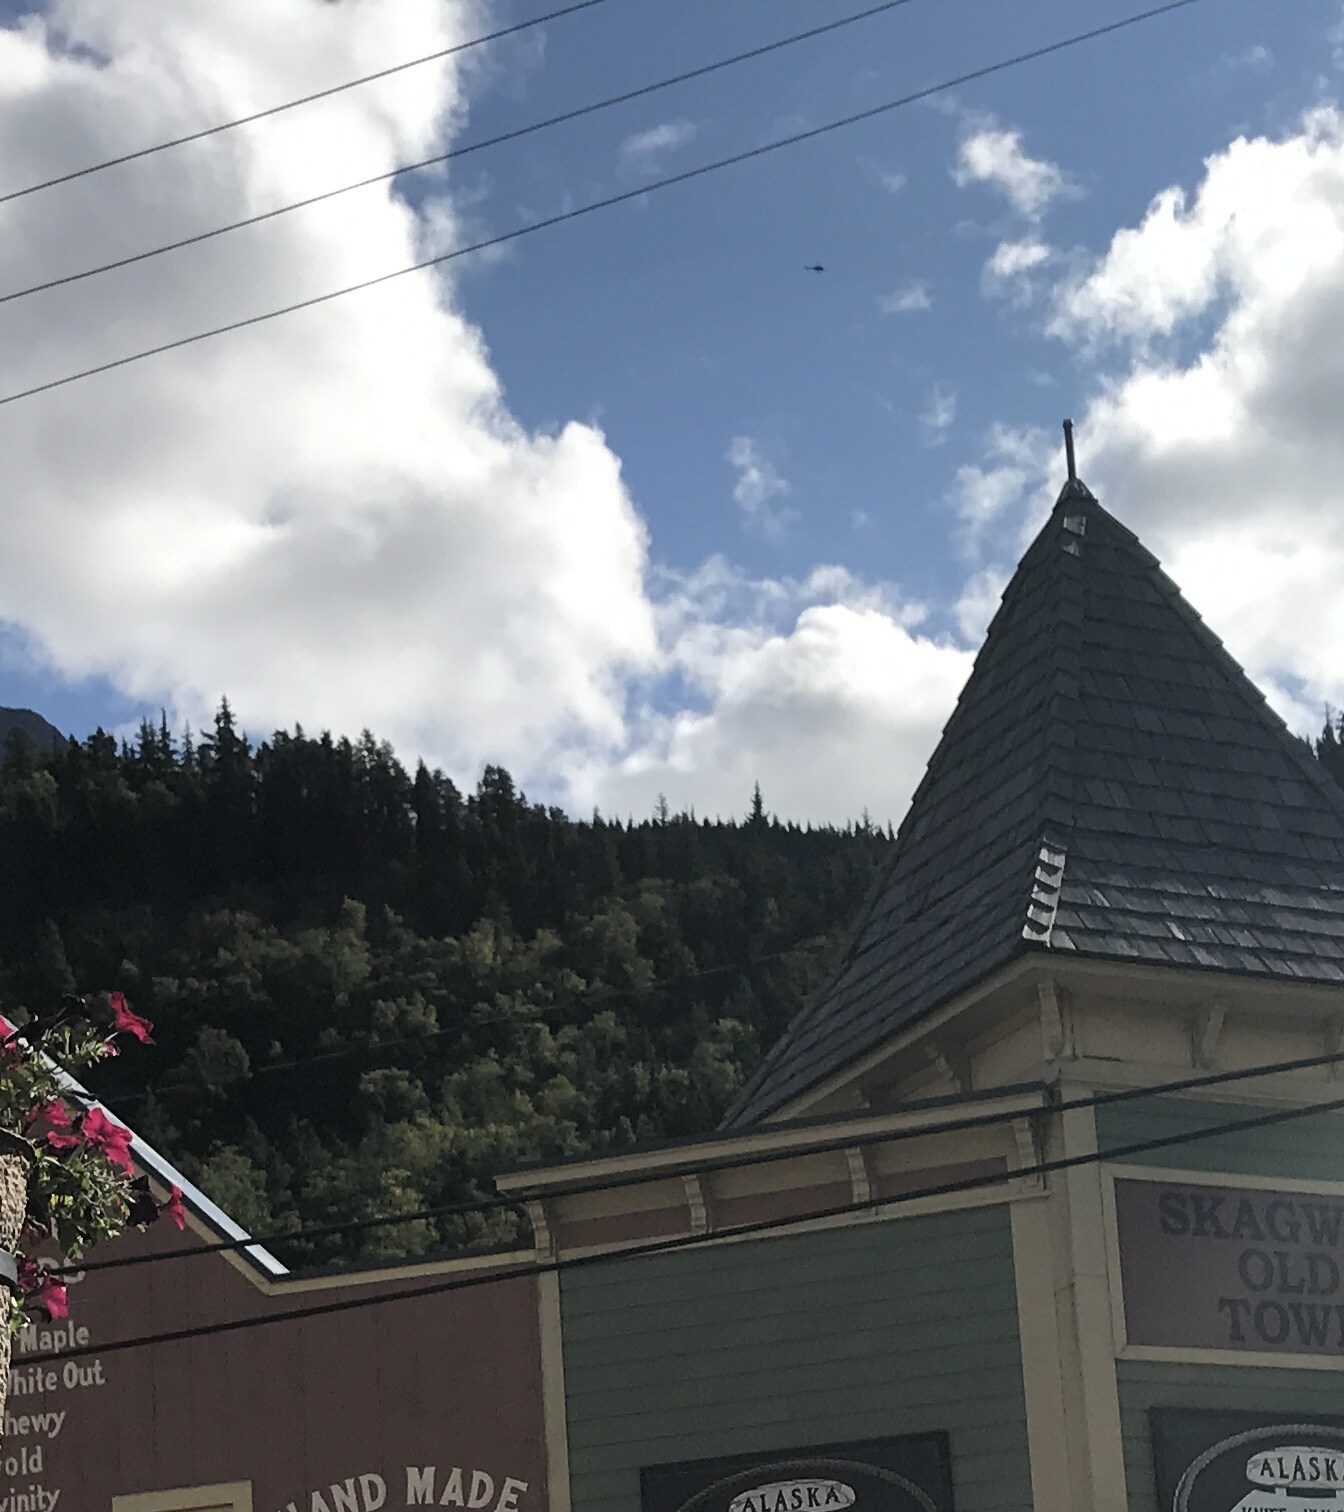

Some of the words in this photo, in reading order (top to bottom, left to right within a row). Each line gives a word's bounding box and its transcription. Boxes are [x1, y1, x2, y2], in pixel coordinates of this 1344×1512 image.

[1238, 1248, 1340, 1296] OLD
[20, 1321, 90, 1354] Maple
[63, 1360, 105, 1388] Out
[3, 1409, 66, 1438] hewy
